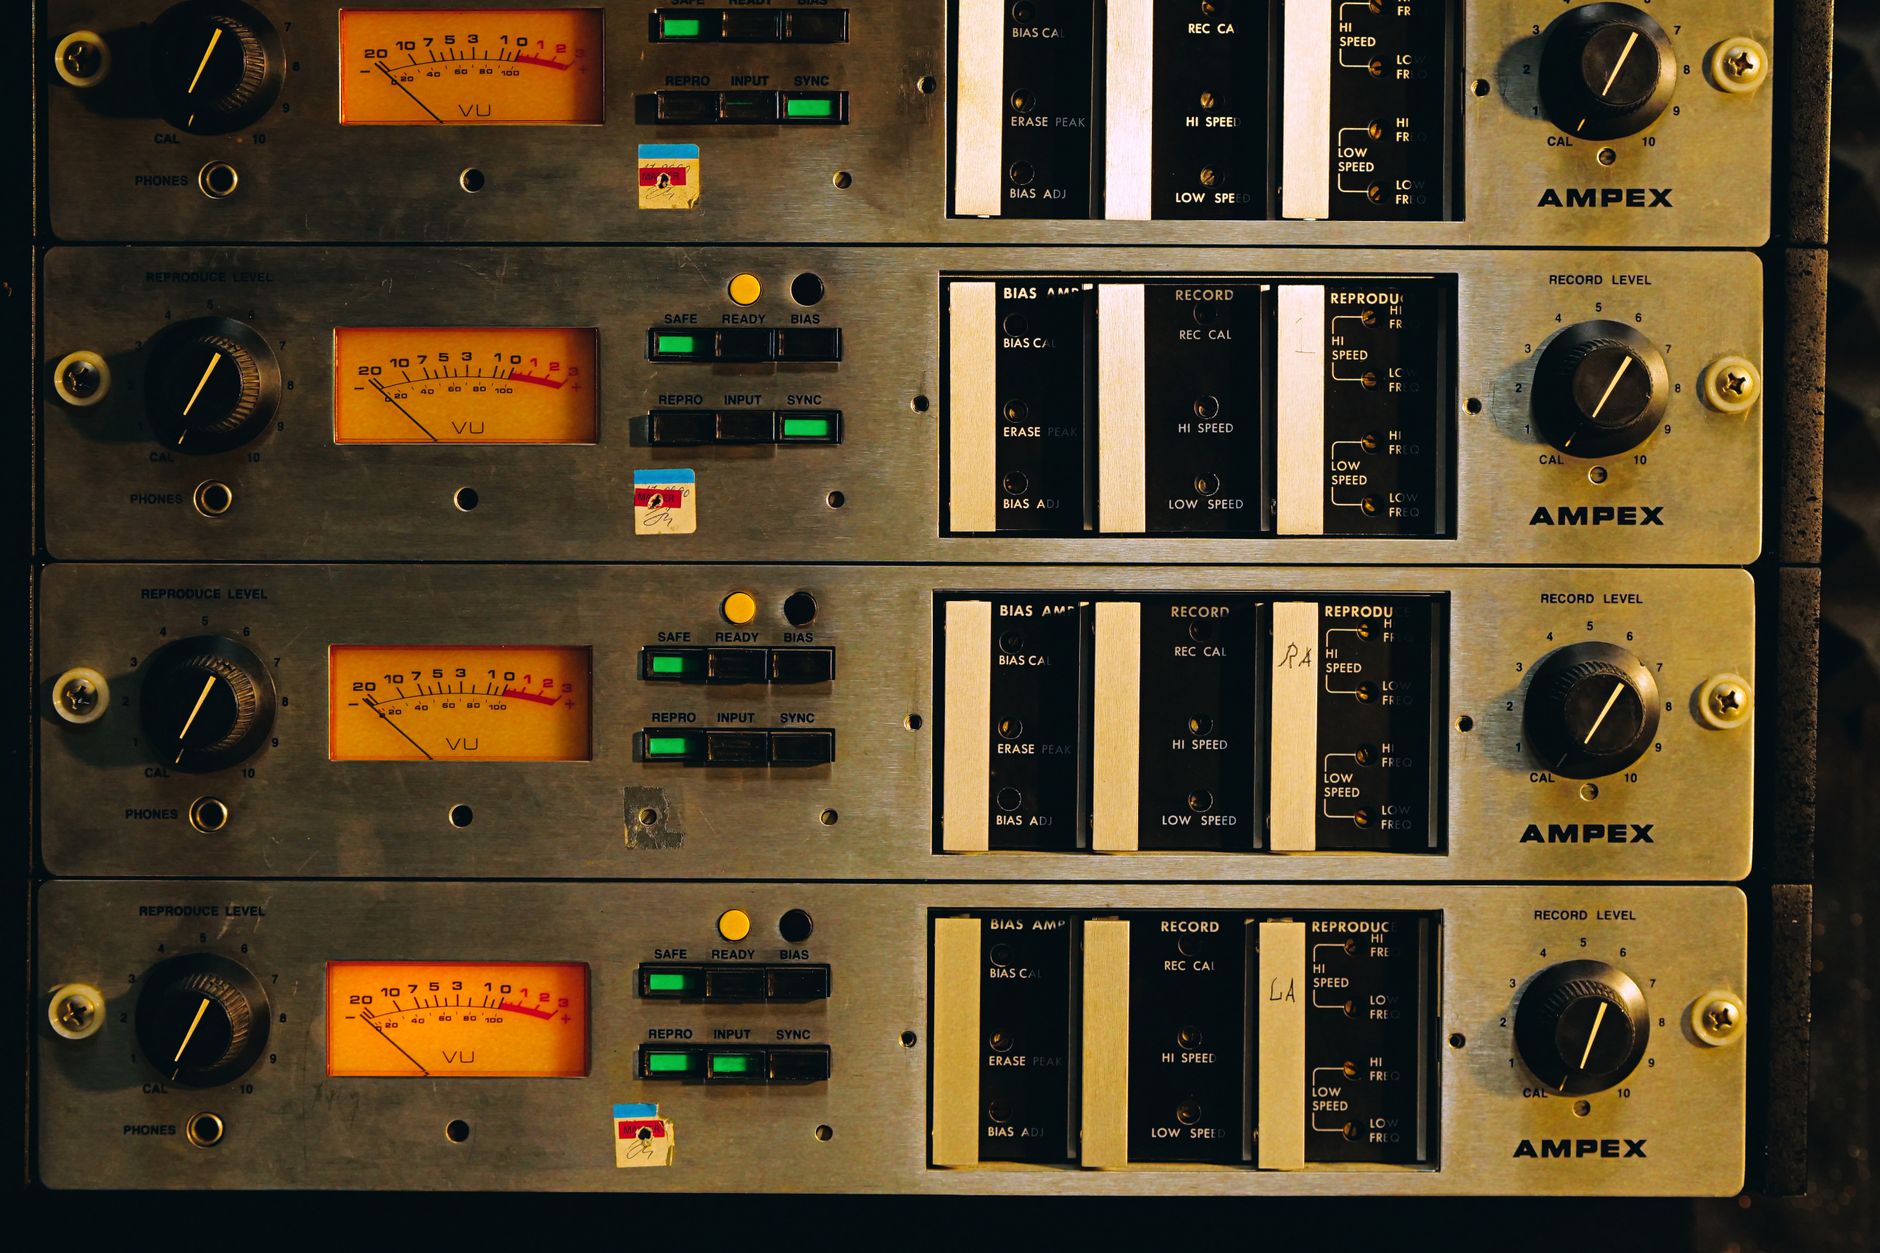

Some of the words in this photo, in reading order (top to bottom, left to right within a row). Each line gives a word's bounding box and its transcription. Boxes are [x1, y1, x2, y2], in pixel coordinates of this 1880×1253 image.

[1188, 24, 1210, 34] REC
[1339, 23, 1352, 32] HI
[1012, 28, 1038, 38] BIAS
[1339, 37, 1376, 47] SPEED
[666, 76, 710, 86] REPRO
[731, 76, 769, 85] INPUT
[794, 76, 829, 86] SYNC
[458, 105, 491, 117] VU
[1011, 117, 1048, 127] ERASE
[1186, 117, 1199, 127] HI
[1396, 118, 1409, 127] HI
[154, 135, 180, 144] CAL
[253, 135, 266, 144] 10
[1548, 137, 1572, 146] CAL
[1338, 148, 1368, 158] LOW
[1338, 162, 1374, 172] SPEED
[135, 176, 188, 186] PHONES
[1009, 188, 1036, 199] BIAS
[1043, 188, 1067, 199] ADJ
[1175, 192, 1205, 203] LOW
[1537, 189, 1673, 207] AMPEX
[146, 272, 226, 282] REPRODUCE
[233, 272, 272, 282] LEVEL
[1549, 275, 1602, 284] RECORD
[1612, 275, 1651, 284] LEVEL
[1003, 288, 1037, 299] BIAS
[1175, 290, 1234, 301] RECORD
[1595, 303, 1602, 312] 5
[664, 314, 698, 323] SAFE
[722, 315, 765, 323] READY
[791, 315, 820, 324] BIAS
[1555, 314, 1561, 322] 4
[1635, 313, 1642, 322] 6
[1179, 330, 1201, 340] REC
[1209, 330, 1232, 340] CAL
[1003, 338, 1030, 348] BIAS
[1332, 337, 1344, 346] HI
[1525, 344, 1531, 353] 3
[1665, 345, 1672, 353] 7
[1332, 350, 1368, 360] SPEED
[1515, 384, 1522, 393] 2
[1674, 384, 1681, 393] 8
[659, 395, 703, 405] REPRO
[724, 395, 762, 405] INPUT
[787, 395, 822, 405] SYNC
[452, 422, 484, 434] VU
[1003, 427, 1040, 437] ERASE
[1178, 424, 1190, 433] HI
[1198, 424, 1234, 434] SPEED
[1525, 425, 1530, 433] 1
[1664, 425, 1671, 433] 9
[150, 453, 174, 462] CAL
[1539, 456, 1564, 465] CAL
[1634, 456, 1647, 464] 10
[1332, 461, 1361, 471] LOW
[1332, 475, 1367, 485] SPEED
[130, 495, 183, 504] PHONES
[1003, 499, 1029, 509] BIAS
[1169, 500, 1198, 510] LOW
[1208, 499, 1244, 510] SPEED
[1529, 507, 1664, 525] AMPEX
[141, 589, 220, 599] REPRODUCE
[228, 589, 267, 599] LEVEL
[1541, 594, 1594, 604] RECORD
[1604, 594, 1643, 604] LEVEL
[1000, 605, 1033, 617] BIAS
[1170, 607, 1229, 617] RECORD
[658, 633, 691, 642] SAFE
[715, 633, 759, 642] READY
[784, 633, 813, 643] BIAS
[1174, 647, 1196, 657] REC
[1204, 647, 1227, 657] CAL
[1325, 649, 1338, 659] HI
[999, 655, 1025, 665] BIAS
[1326, 663, 1362, 673] SPEED
[652, 713, 696, 723] REPRO
[717, 713, 755, 723] INPUT
[780, 713, 815, 723] SYNC
[446, 738, 478, 750] VU
[997, 744, 1035, 754] ERASE
[1173, 739, 1185, 749] HI
[1192, 739, 1228, 750] SPEED
[145, 768, 170, 777] CAL
[1530, 773, 1555, 782] CAL
[1324, 773, 1353, 783] LOW
[1324, 788, 1360, 797] SPEED
[126, 809, 178, 819] PHONES
[996, 816, 1022, 826] BIAS
[1162, 816, 1191, 826] LOW
[1201, 815, 1237, 826] SPEED
[1520, 824, 1654, 843] AMPEX
[139, 907, 218, 916] REPRODUCE
[226, 907, 265, 916] LEVEL
[1534, 911, 1588, 920] RECORD
[1597, 911, 1636, 920] LEVEL
[990, 920, 1023, 930] BIAS
[1161, 922, 1220, 932] RECORD
[1370, 934, 1383, 943] HI
[655, 949, 687, 959] SAFE
[712, 950, 755, 959] READY
[780, 950, 810, 959] BIAS
[1164, 961, 1186, 970] REC
[1313, 964, 1325, 973] HI
[990, 968, 1016, 978] BIAS
[1313, 978, 1349, 988] SPEED
[350, 995, 373, 1004] 20
[381, 988, 400, 996] 10
[408, 985, 418, 993] 7
[429, 982, 440, 991] 5
[452, 981, 463, 990] 3
[484, 983, 492, 991] 1
[500, 985, 512, 994] 0
[649, 1029, 693, 1039] REPRO
[714, 1030, 751, 1039] INPUT
[776, 1030, 811, 1040] SYNC
[442, 1051, 475, 1063] VU
[989, 1056, 1026, 1066] ERASE
[1162, 1053, 1174, 1063] HI
[1181, 1053, 1216, 1063] SPEED
[1370, 1057, 1382, 1067] HI
[143, 1084, 168, 1094] CAL
[240, 1085, 252, 1094] 10
[1312, 1087, 1341, 1097] LOW
[1523, 1088, 1548, 1098] CAL
[1313, 1101, 1348, 1111] SPEED
[124, 1126, 176, 1135] PHONES
[988, 1127, 1014, 1137] BIAS
[1151, 1128, 1180, 1139] LOW
[1513, 1140, 1647, 1157] AMPEX
